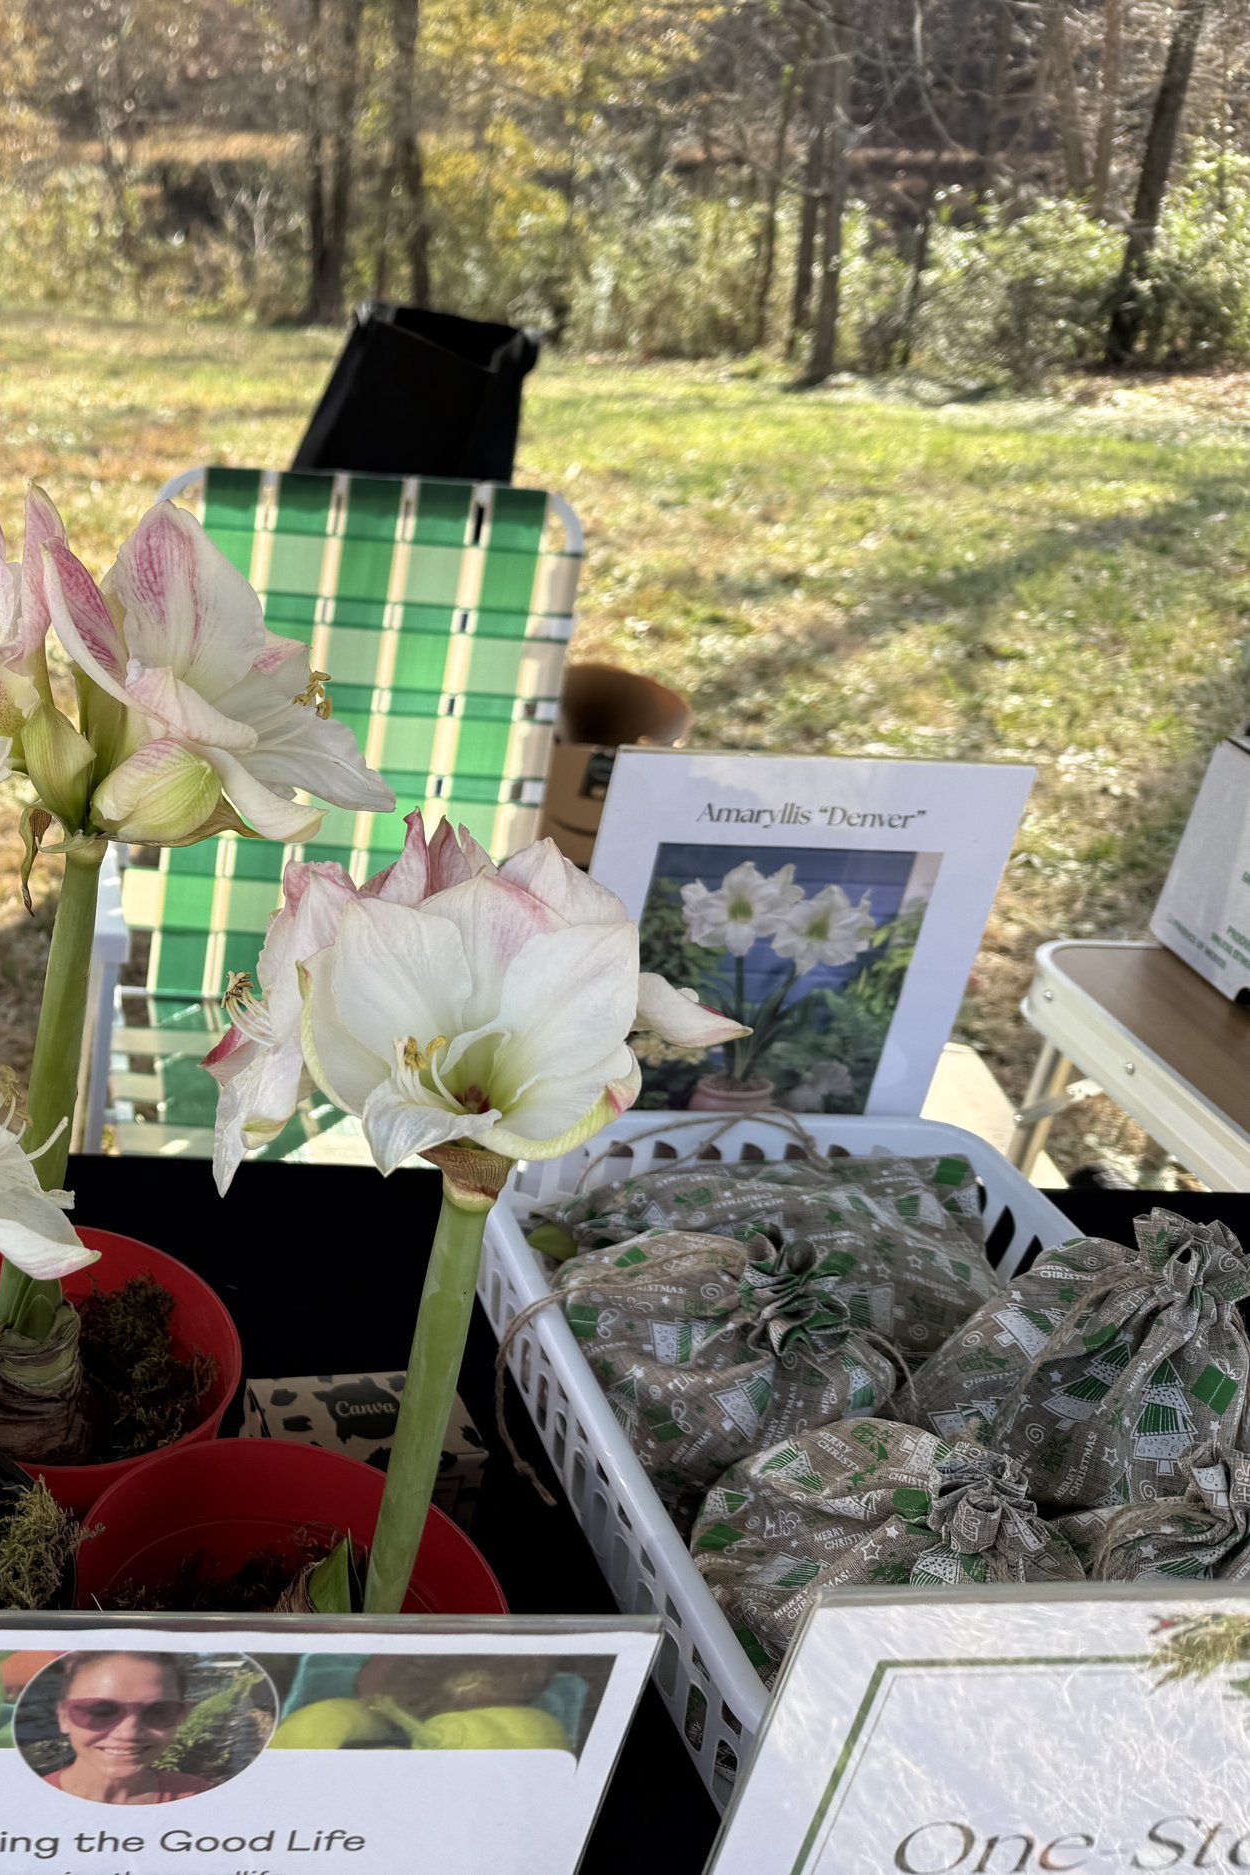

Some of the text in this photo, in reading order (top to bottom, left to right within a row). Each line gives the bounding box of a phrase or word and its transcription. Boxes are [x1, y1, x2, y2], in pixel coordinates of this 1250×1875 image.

[696, 802, 926, 828] Amaryllis “Denver”
[1040, 1270, 1097, 1282] CHRISTMA
[335, 1400, 397, 1417] Canva
[816, 1439, 859, 1471] CHRIST
[1053, 1465, 1078, 1500] MERRY
[813, 1526, 845, 1542] MERRY
[773, 1588, 810, 1620] MERRY
[73, 1830, 145, 1853] the
[159, 1829, 275, 1854] Good
[285, 1829, 367, 1853] Life
